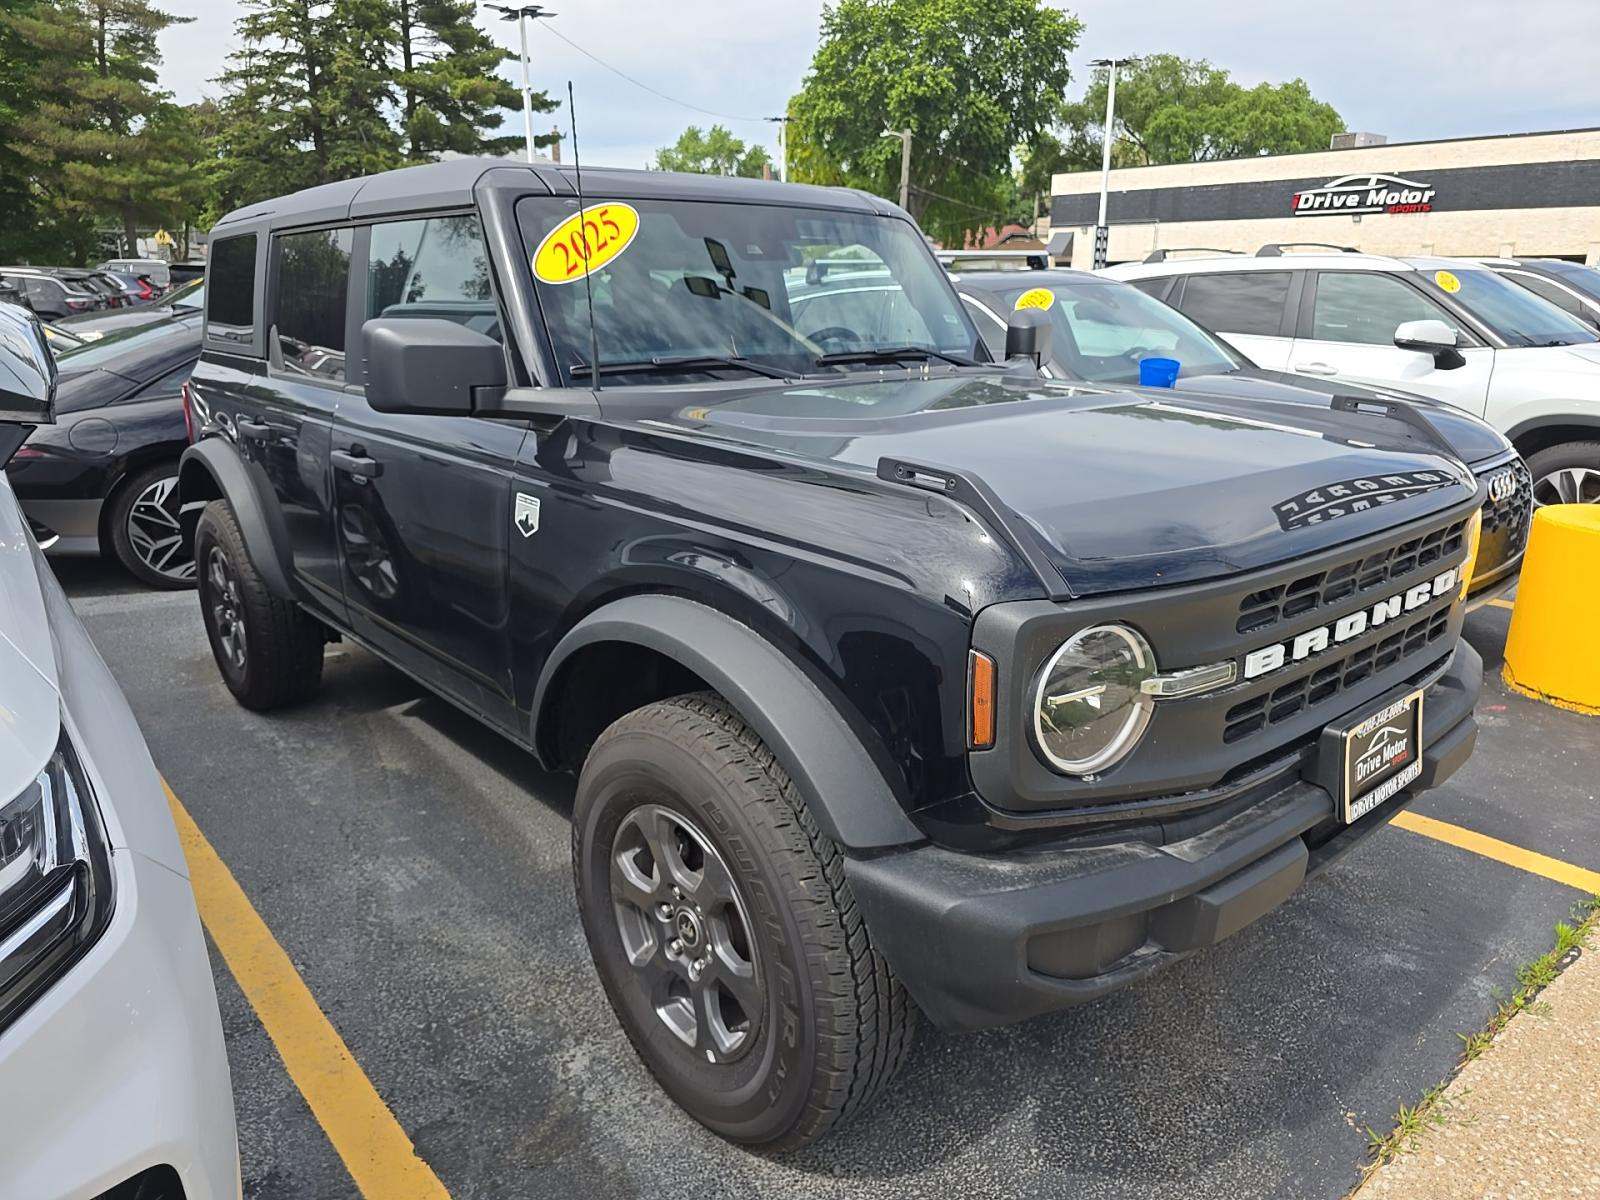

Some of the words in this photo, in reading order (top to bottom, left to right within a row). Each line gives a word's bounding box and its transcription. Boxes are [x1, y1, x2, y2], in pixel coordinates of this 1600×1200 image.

[1366, 189, 1436, 206] Motor
[1389, 203, 1432, 214] SPORTS
[553, 209, 620, 275] 2025
[1244, 569, 1456, 678] BRONCO
[1383, 738, 1408, 763] Motor
[1375, 775, 1398, 807] MOTOR
[1397, 762, 1419, 791] SPORTS
